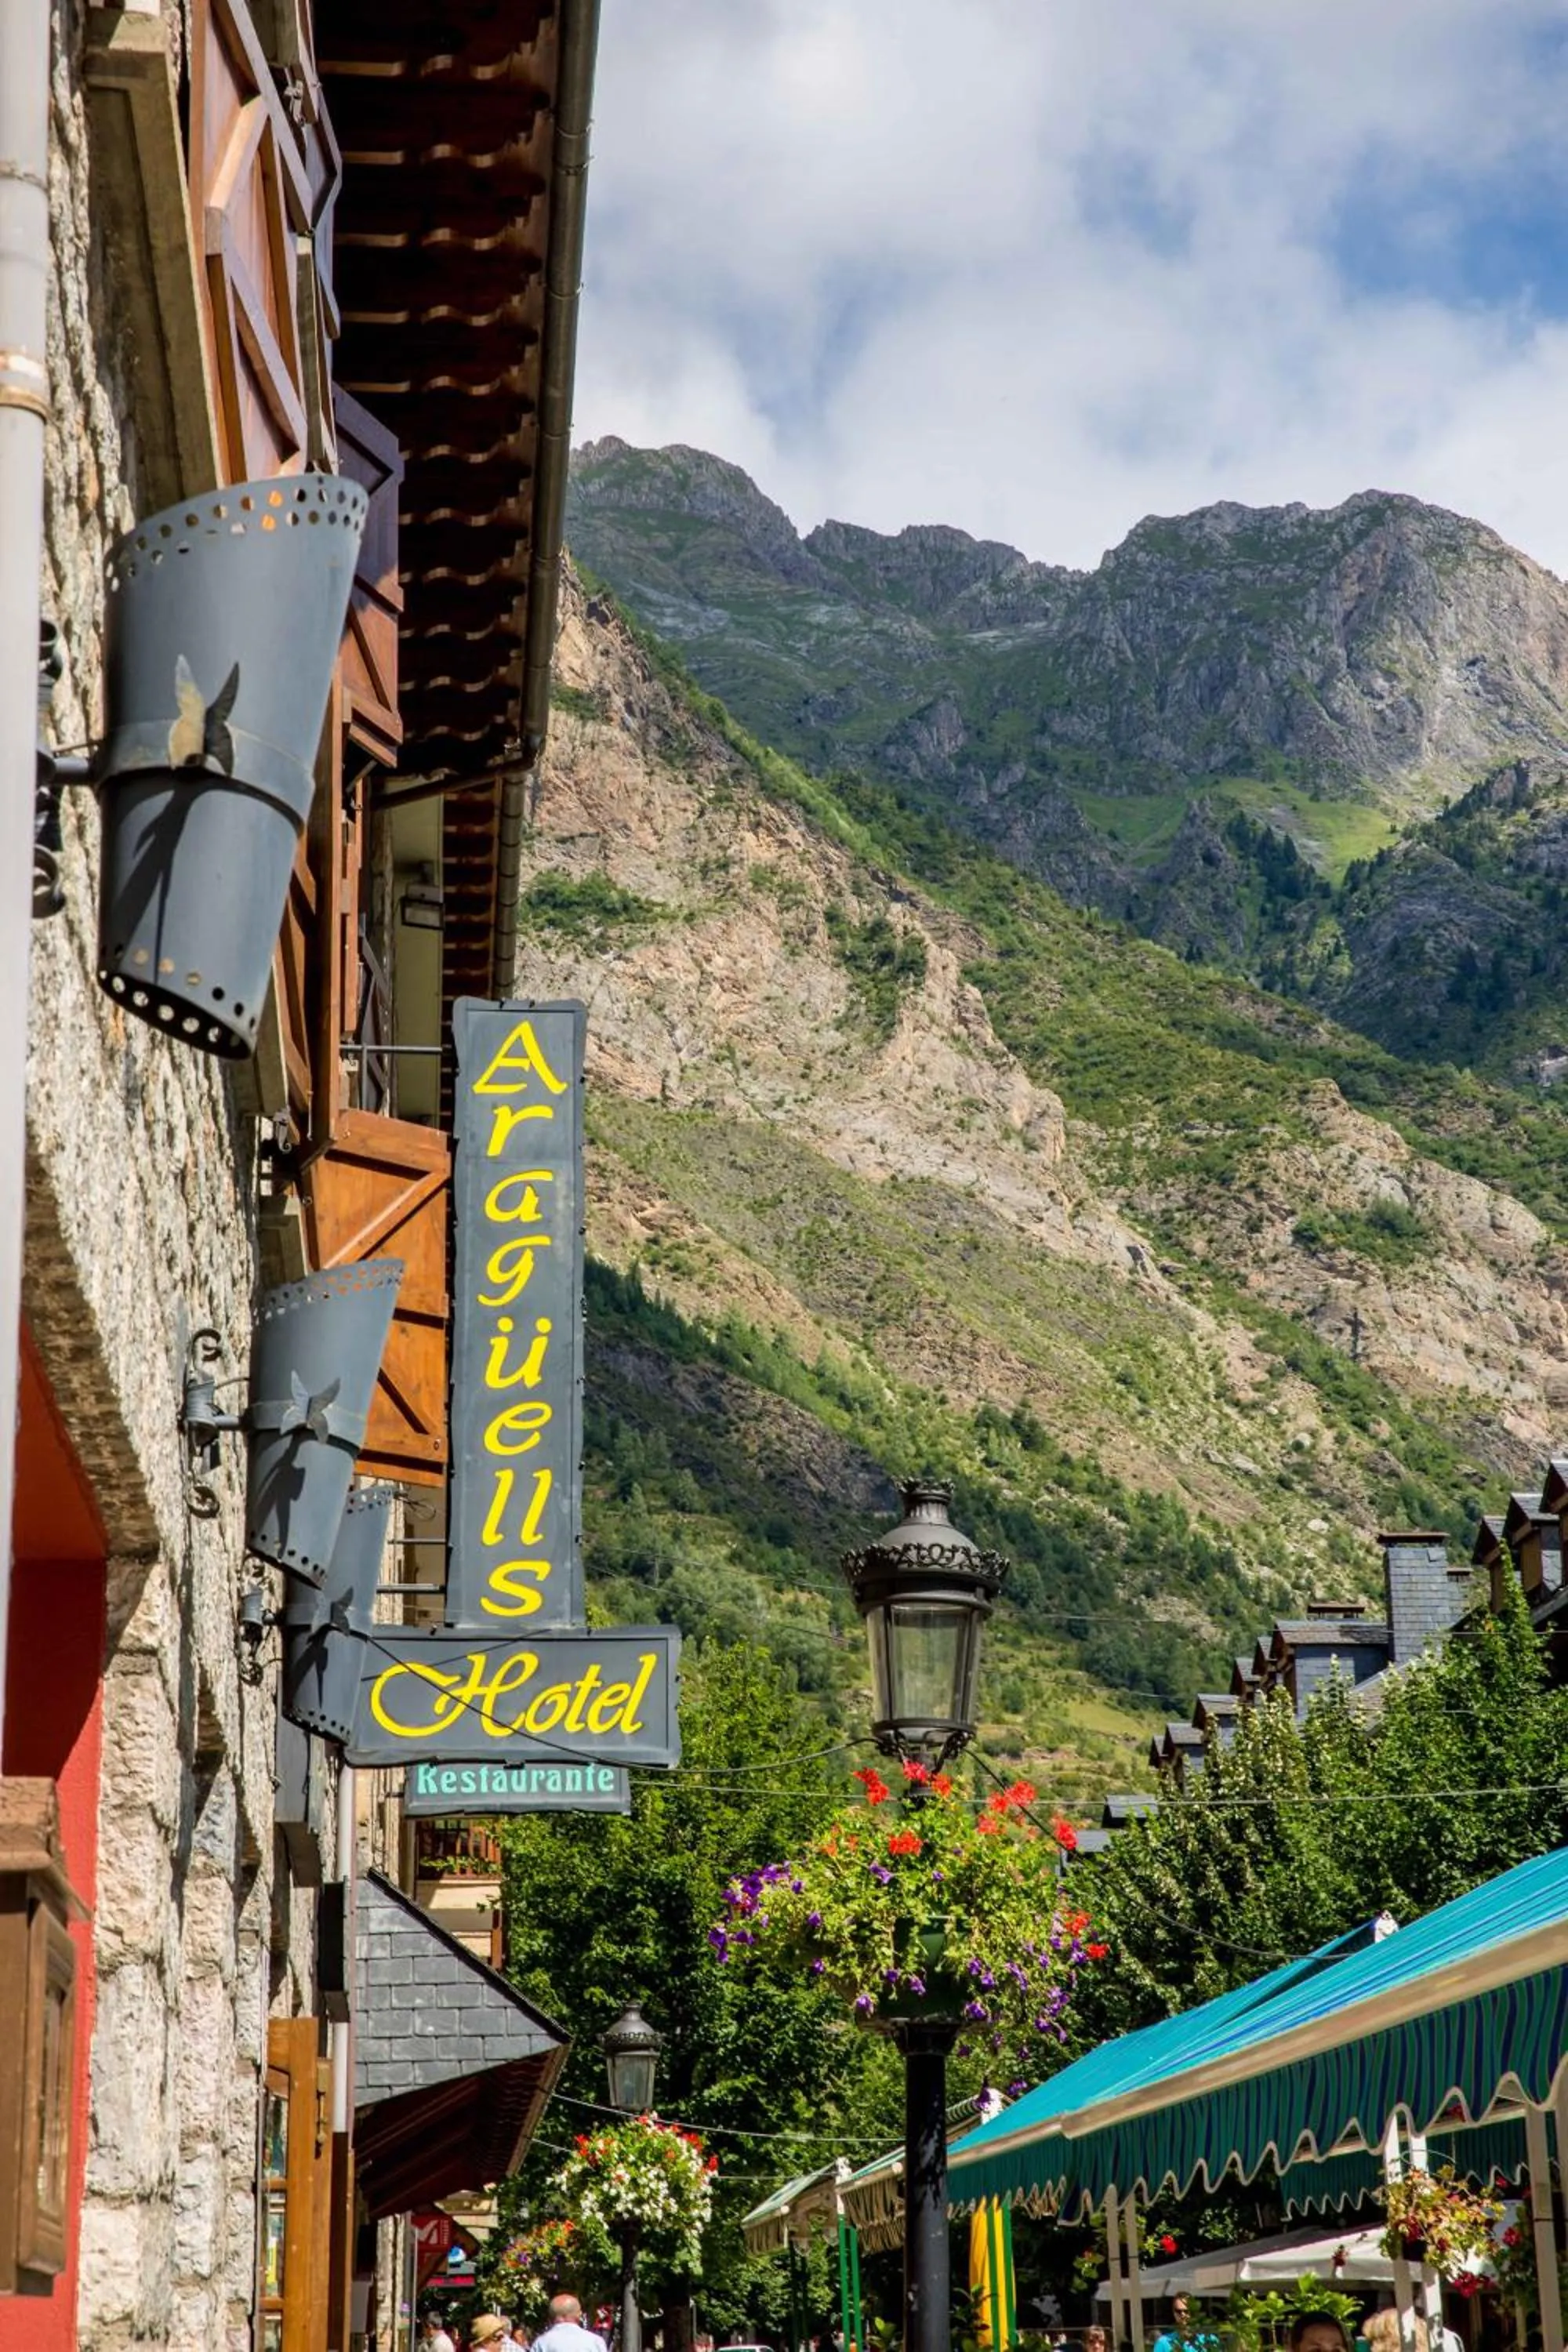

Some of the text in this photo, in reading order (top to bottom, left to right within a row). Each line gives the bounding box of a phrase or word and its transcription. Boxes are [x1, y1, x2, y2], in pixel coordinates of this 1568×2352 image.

[472, 1020, 567, 1617] Aragüells
[370, 1651, 657, 1737] Hotel
[417, 1763, 615, 1794] Restaurante
